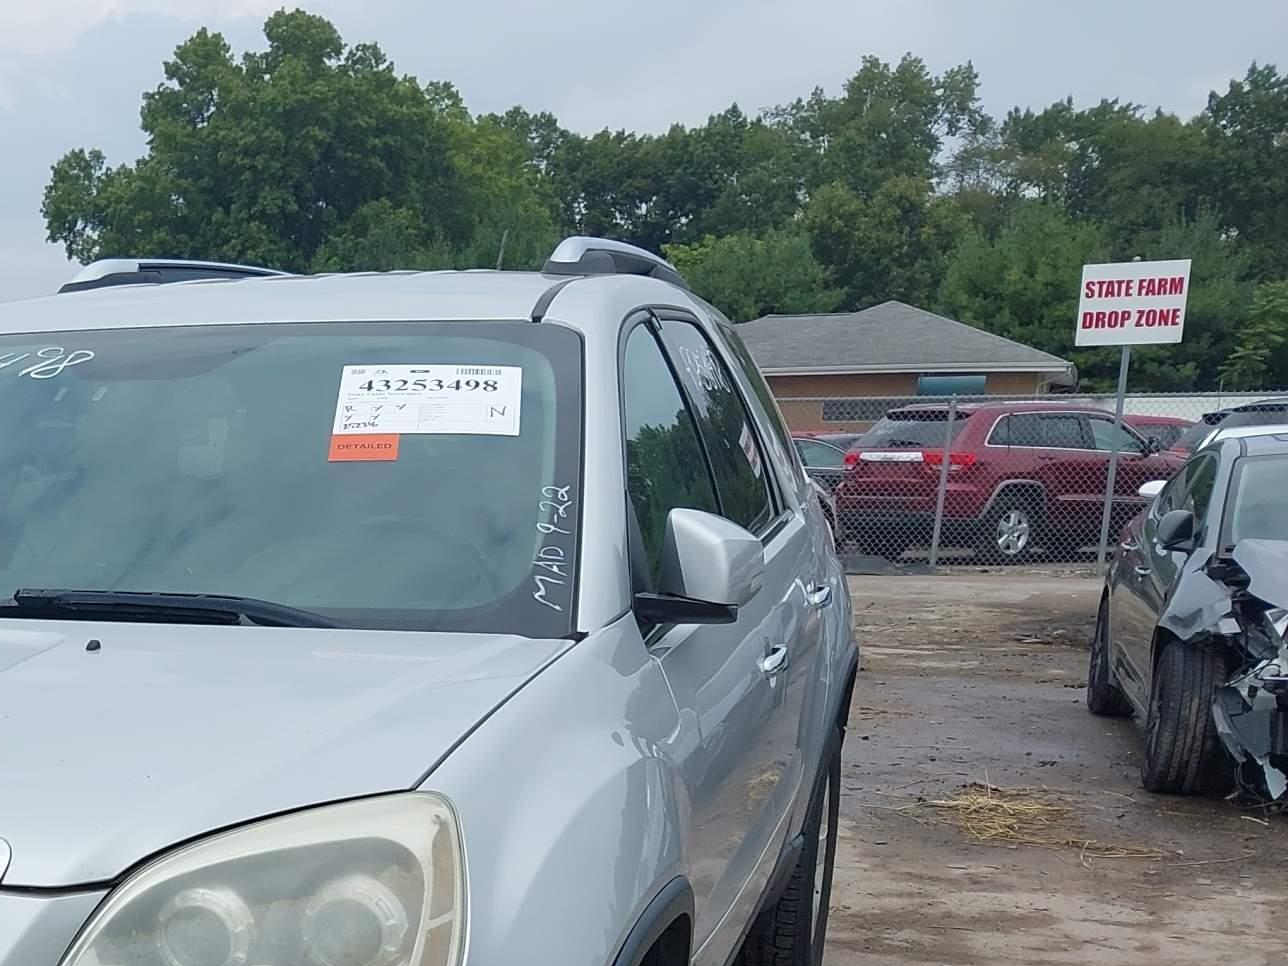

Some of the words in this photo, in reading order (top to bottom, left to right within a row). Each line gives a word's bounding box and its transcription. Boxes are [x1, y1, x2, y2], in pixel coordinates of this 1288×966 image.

[1085, 280, 1134, 299] STATE
[1137, 277, 1185, 297] FARM
[1081, 310, 1132, 329] DROP
[1134, 308, 1181, 328] ZONE
[359, 379, 499, 392] 43253498
[532, 546, 569, 612] MAD
